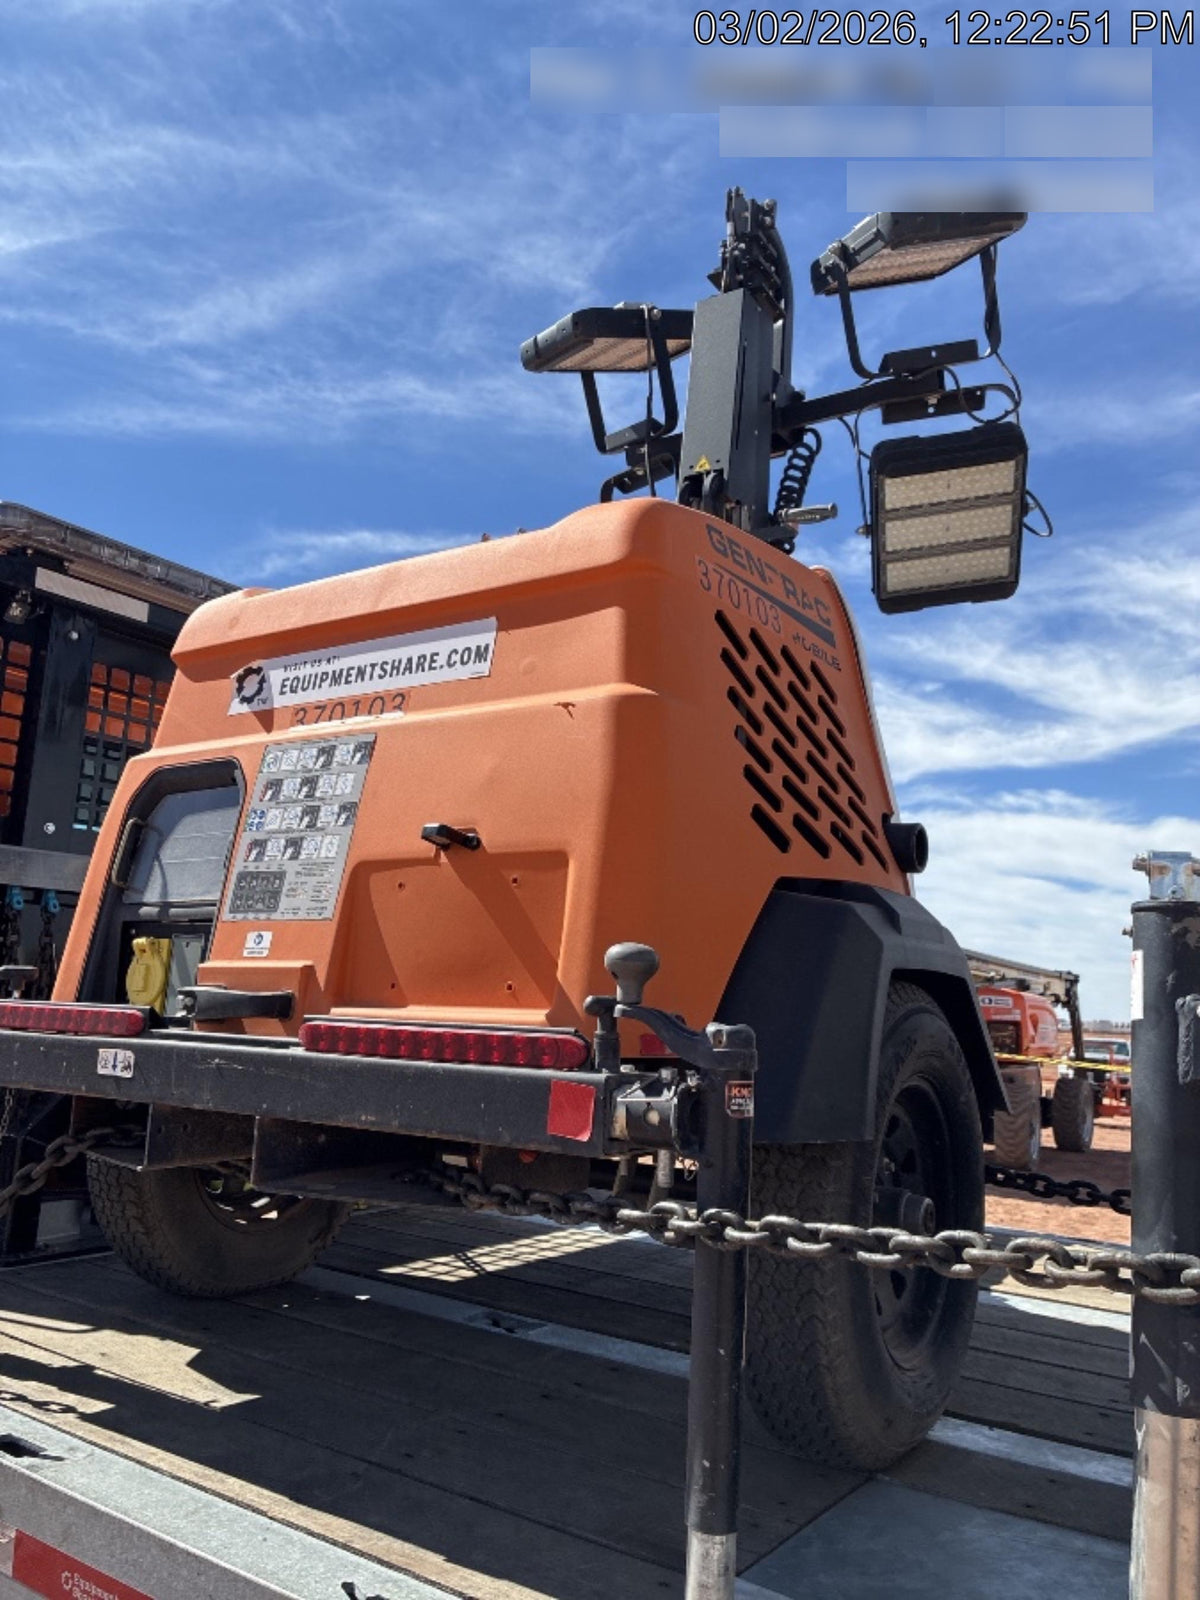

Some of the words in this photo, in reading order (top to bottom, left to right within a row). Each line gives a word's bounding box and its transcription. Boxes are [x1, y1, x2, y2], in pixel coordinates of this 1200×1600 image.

[698, 559, 781, 634] 370103
[706, 523, 833, 627] GENRAC
[279, 642, 491, 696] EQUIPMENTSHARE.COM
[294, 693, 406, 725] 370103
